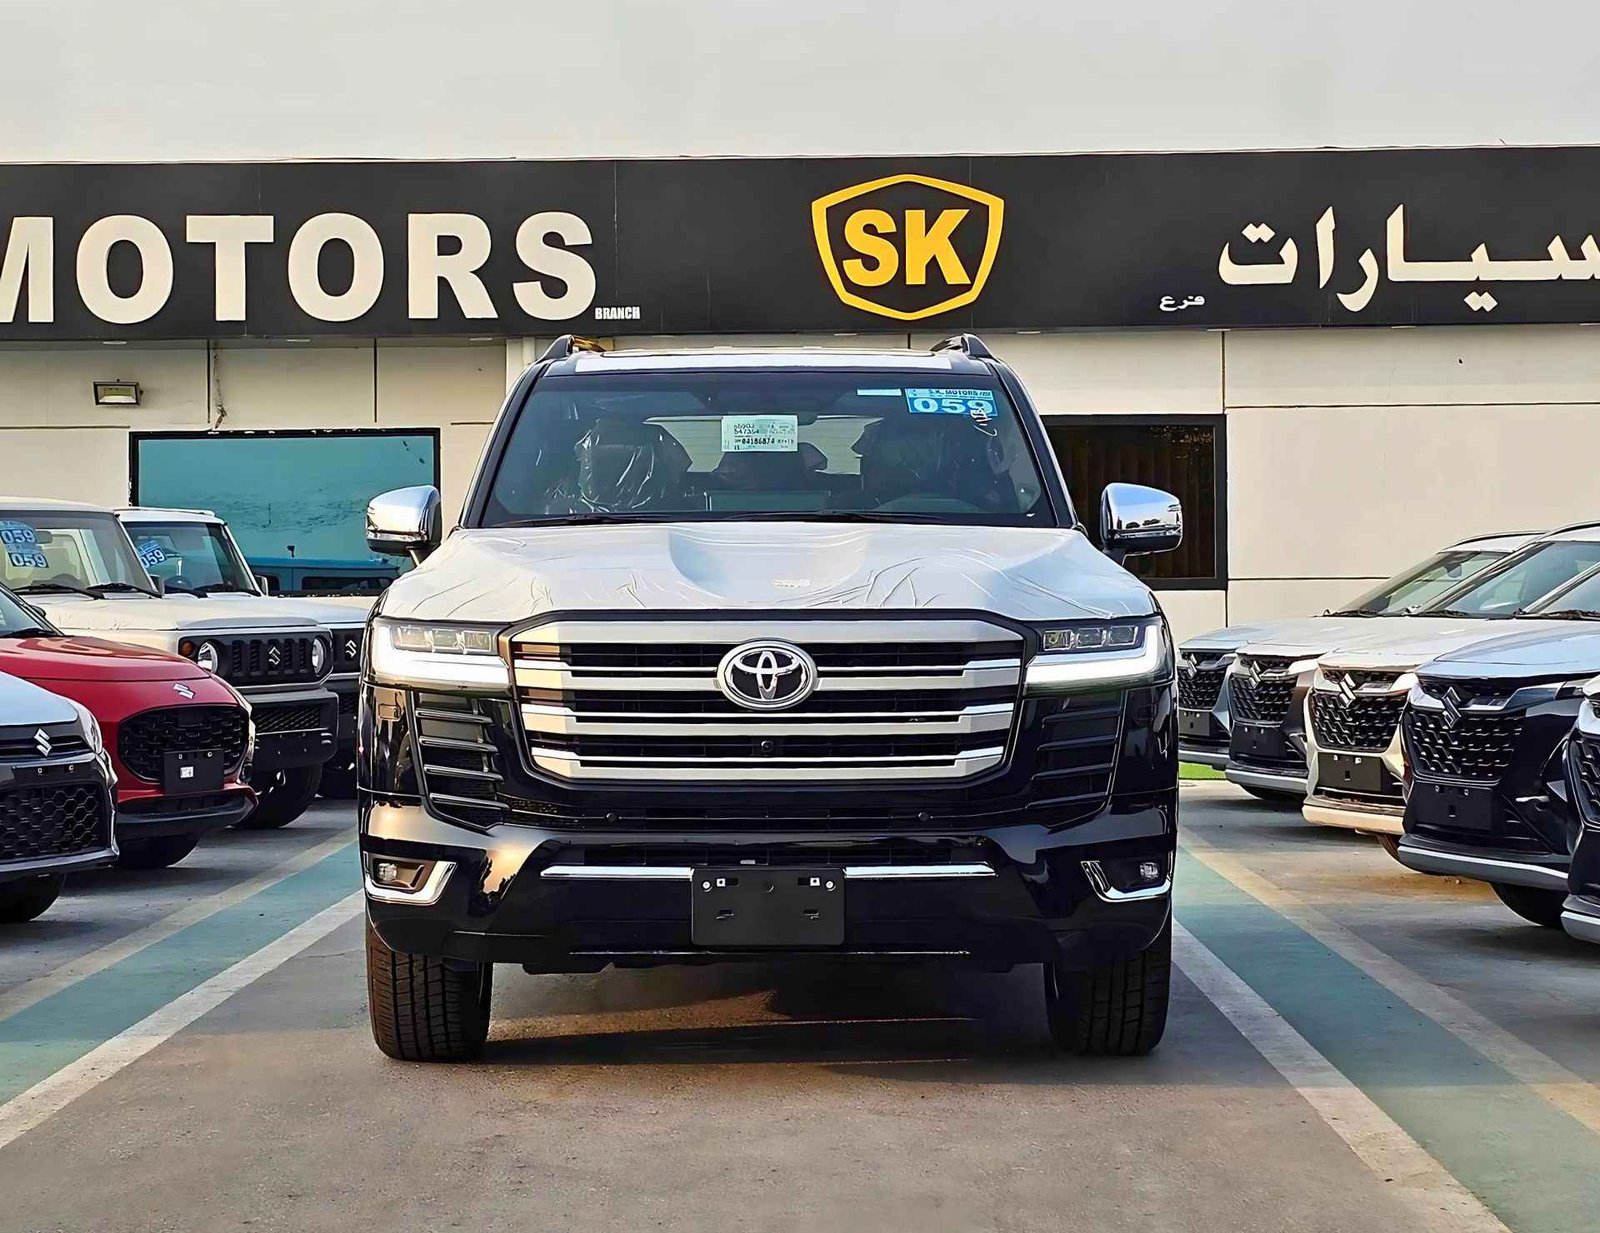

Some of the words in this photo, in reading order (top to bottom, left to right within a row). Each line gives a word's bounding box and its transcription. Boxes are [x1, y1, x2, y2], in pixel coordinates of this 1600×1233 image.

[842, 209, 971, 287] SK
[0, 211, 596, 324] MOTORS
[1159, 295, 1205, 311] فرع
[595, 306, 640, 320] BRANCH
[913, 398, 993, 414] 059
[1, 530, 36, 544] 059
[10, 553, 48, 568] 059
